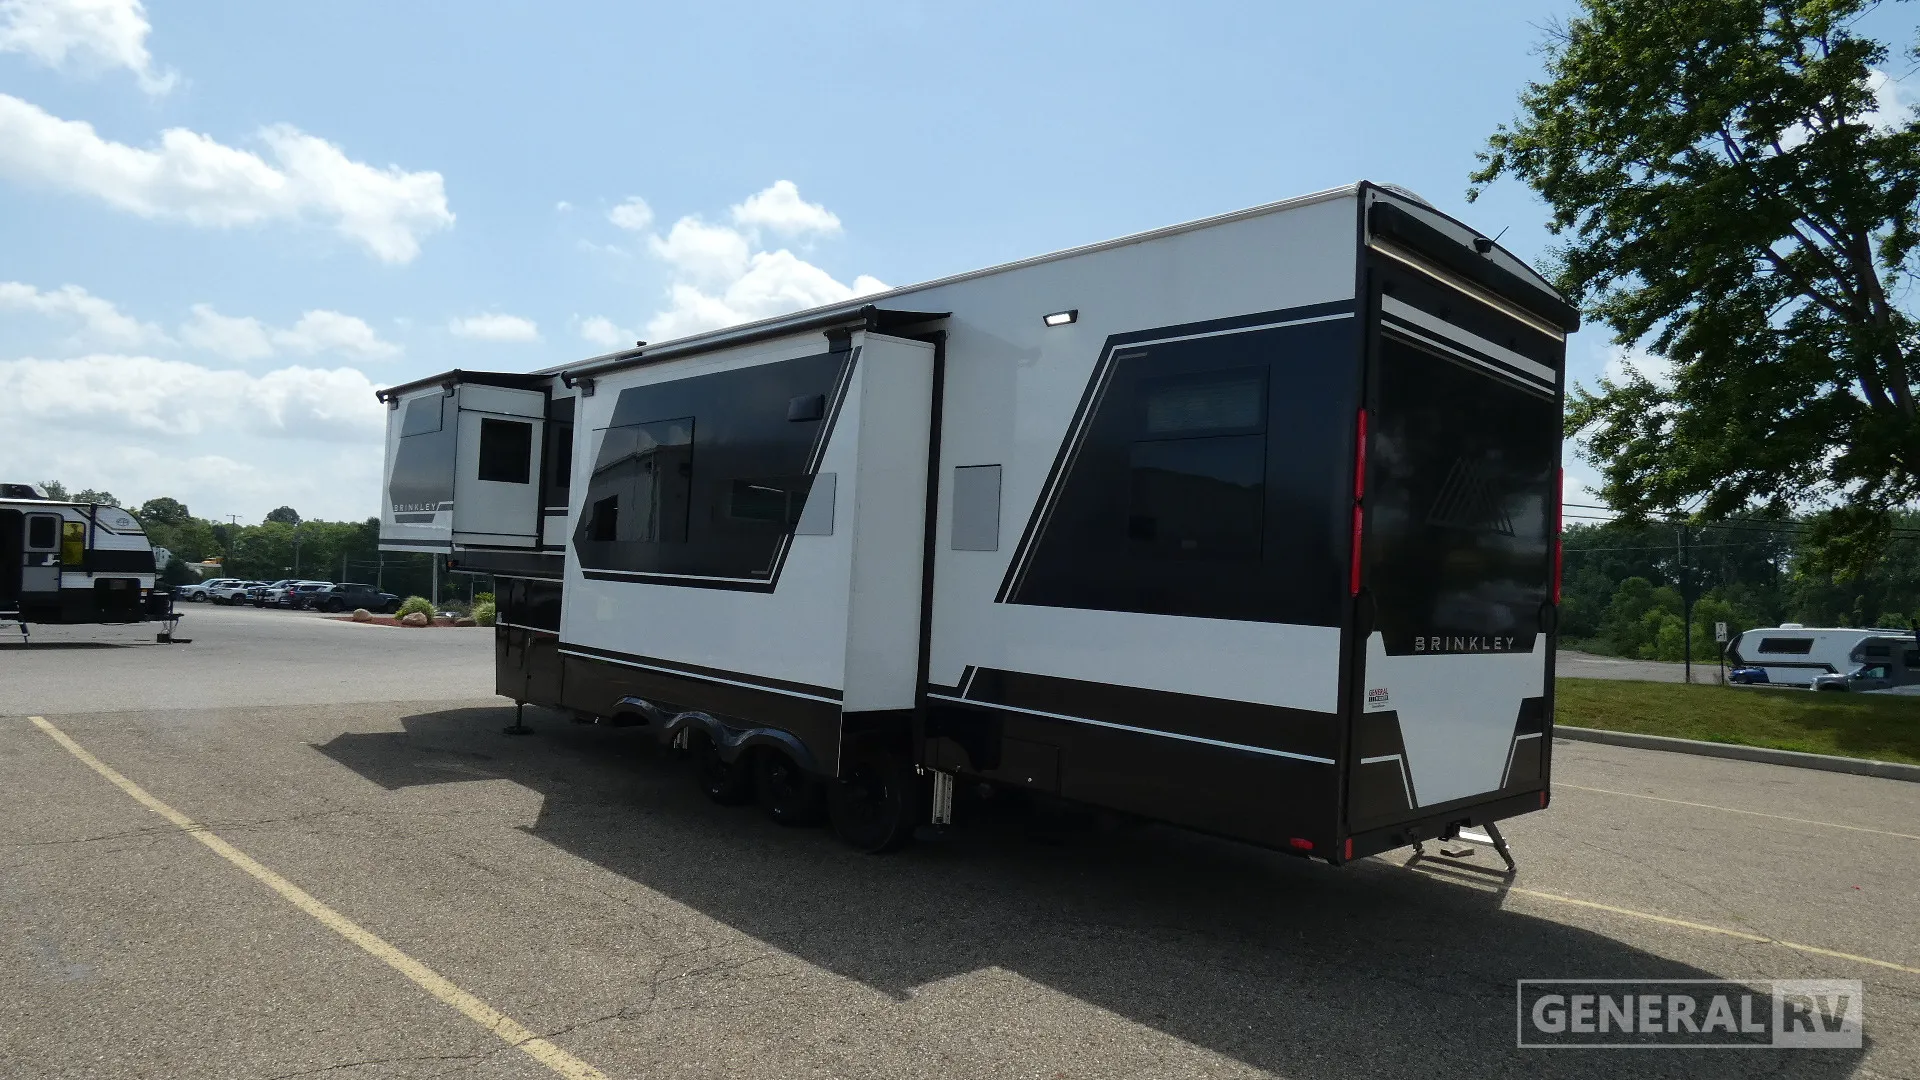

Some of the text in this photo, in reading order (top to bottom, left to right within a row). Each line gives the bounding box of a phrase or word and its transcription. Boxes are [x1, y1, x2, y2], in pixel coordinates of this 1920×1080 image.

[394, 503, 436, 511] BRINKLEY
[1415, 636, 1514, 651] BRINKLEY
[1369, 688, 1388, 696] GENERAL
